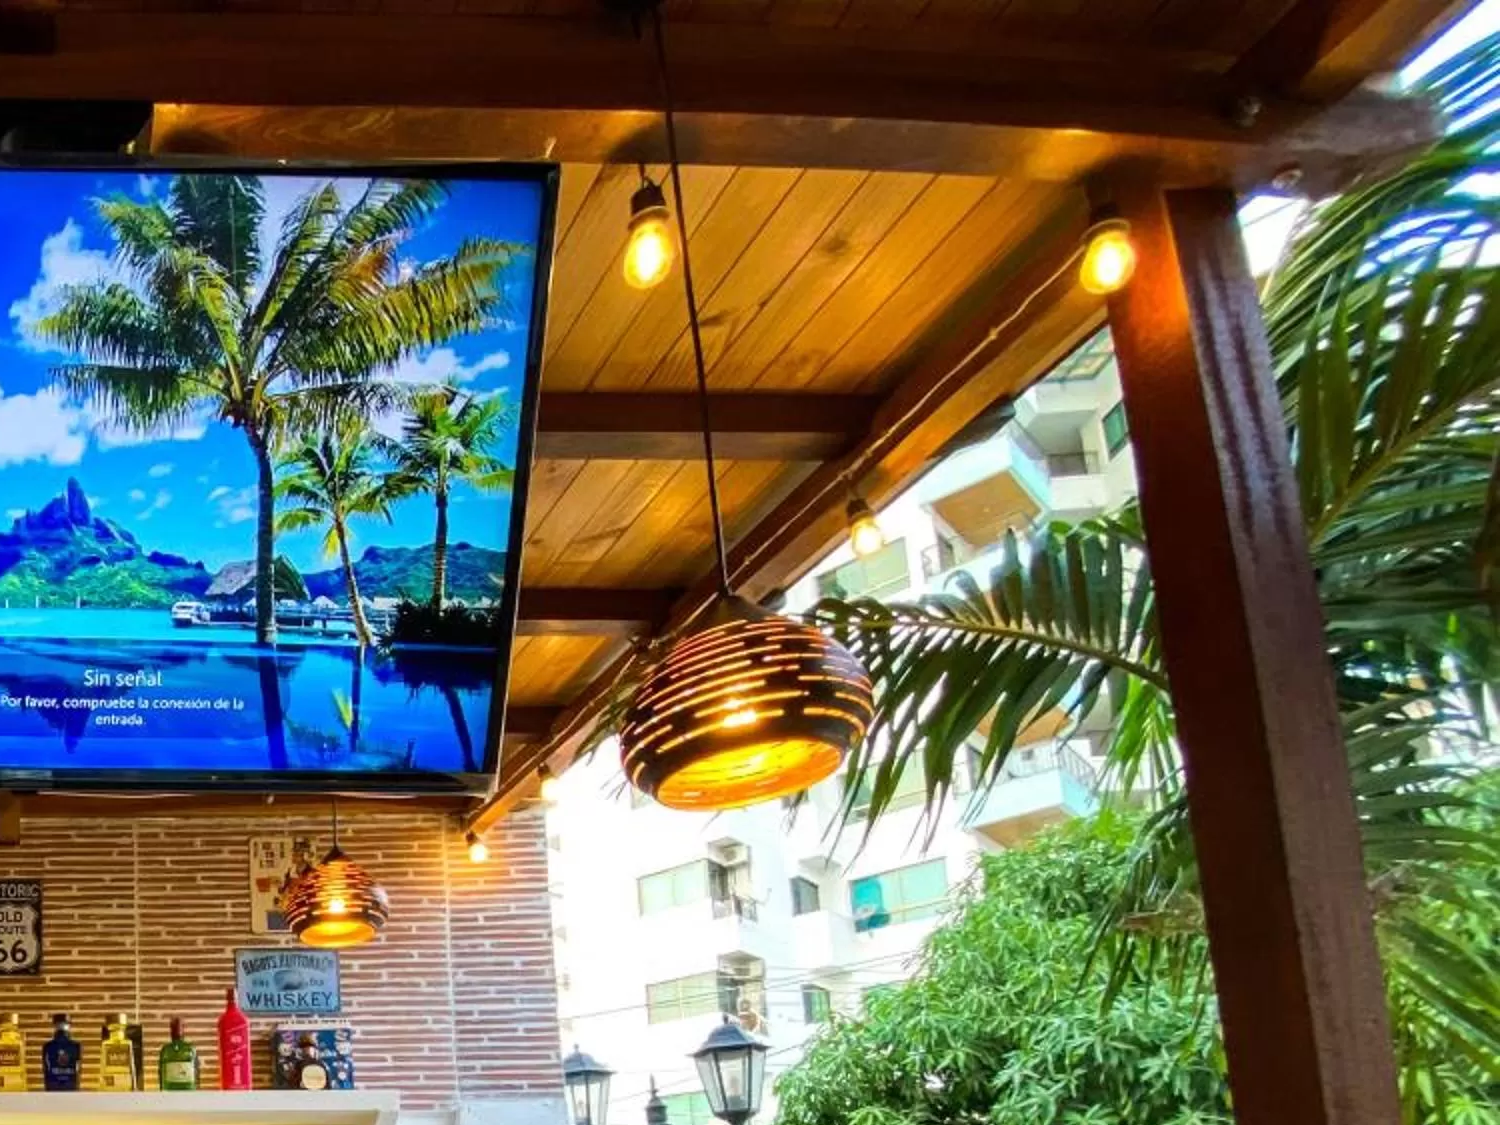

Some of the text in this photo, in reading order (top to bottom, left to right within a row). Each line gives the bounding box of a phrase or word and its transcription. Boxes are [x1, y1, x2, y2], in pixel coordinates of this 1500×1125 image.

[83, 668, 163, 687] Sin señal
[0, 693, 244, 711] Por favor, compruebe la conexión de la
[245, 991, 333, 1007] WHISKEY
